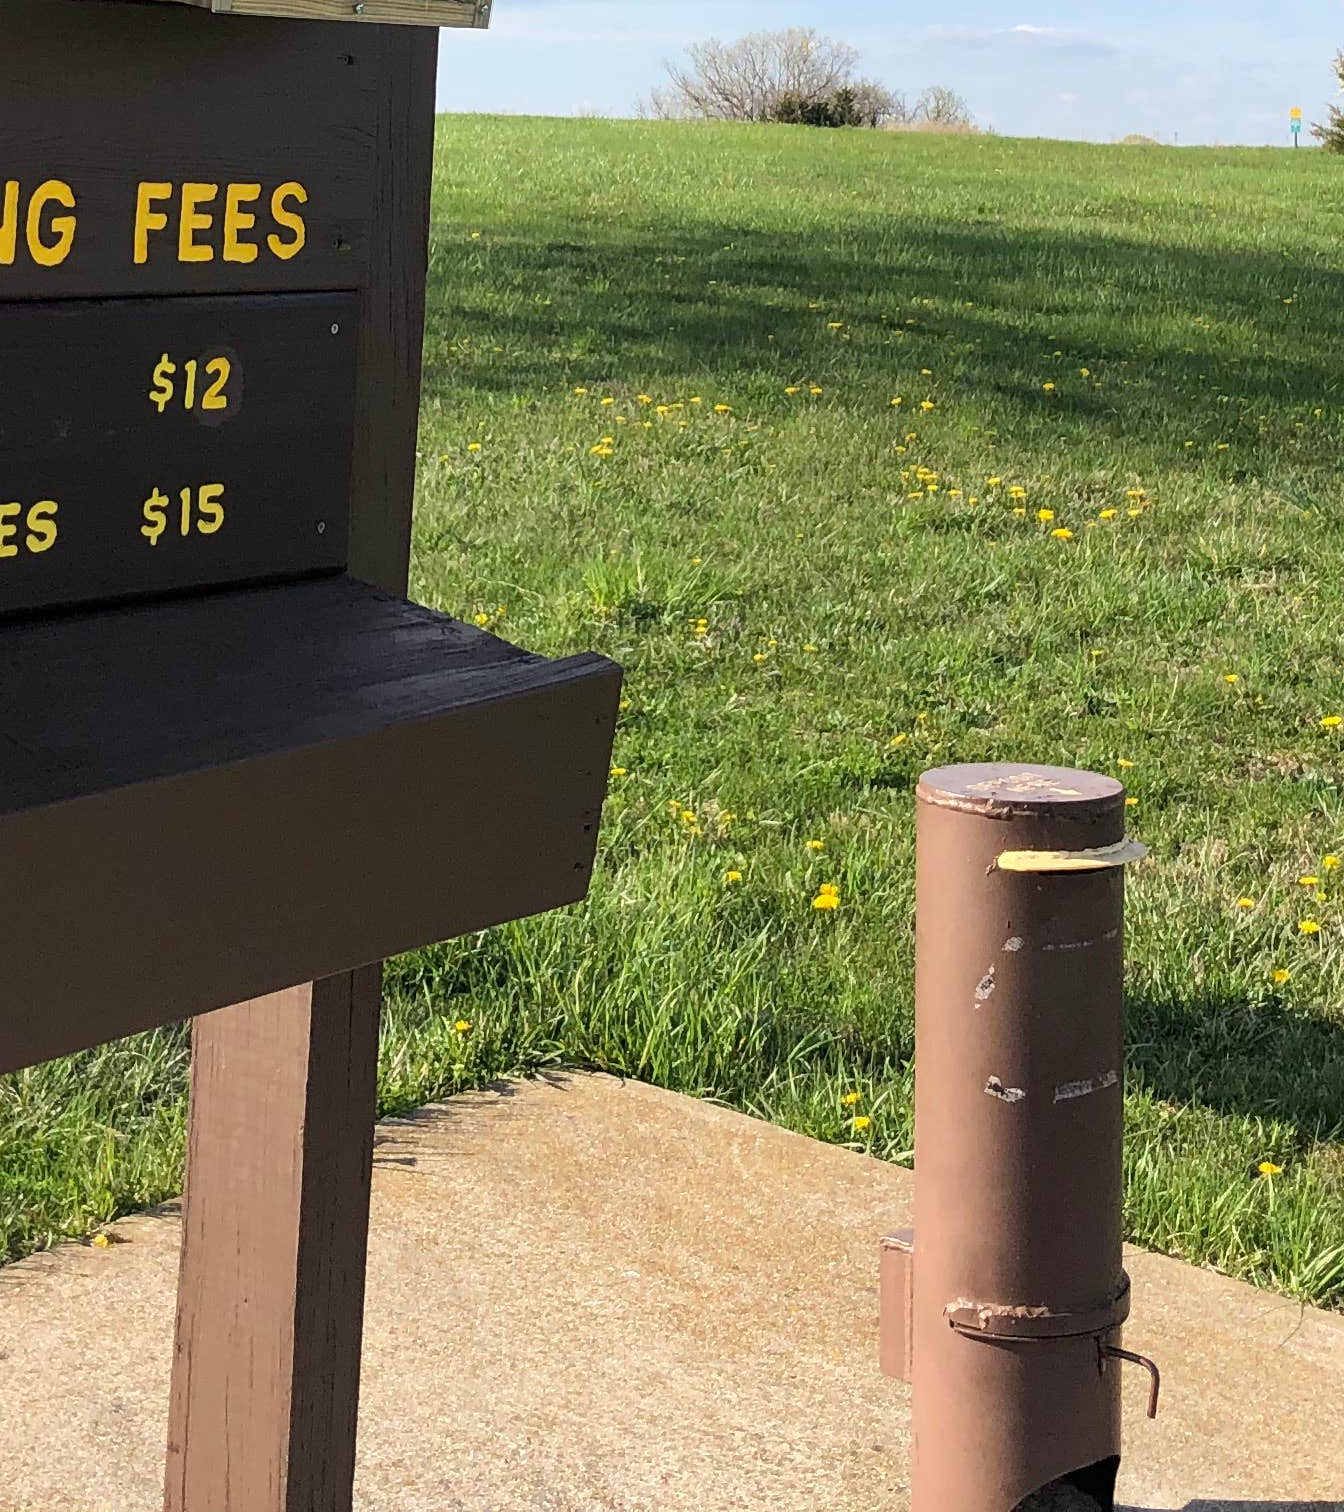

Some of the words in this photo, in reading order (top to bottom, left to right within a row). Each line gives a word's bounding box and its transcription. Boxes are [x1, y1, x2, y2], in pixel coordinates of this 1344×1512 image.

[134, 182, 307, 264] FEES
[149, 353, 230, 412] $12
[141, 484, 224, 546] $15
